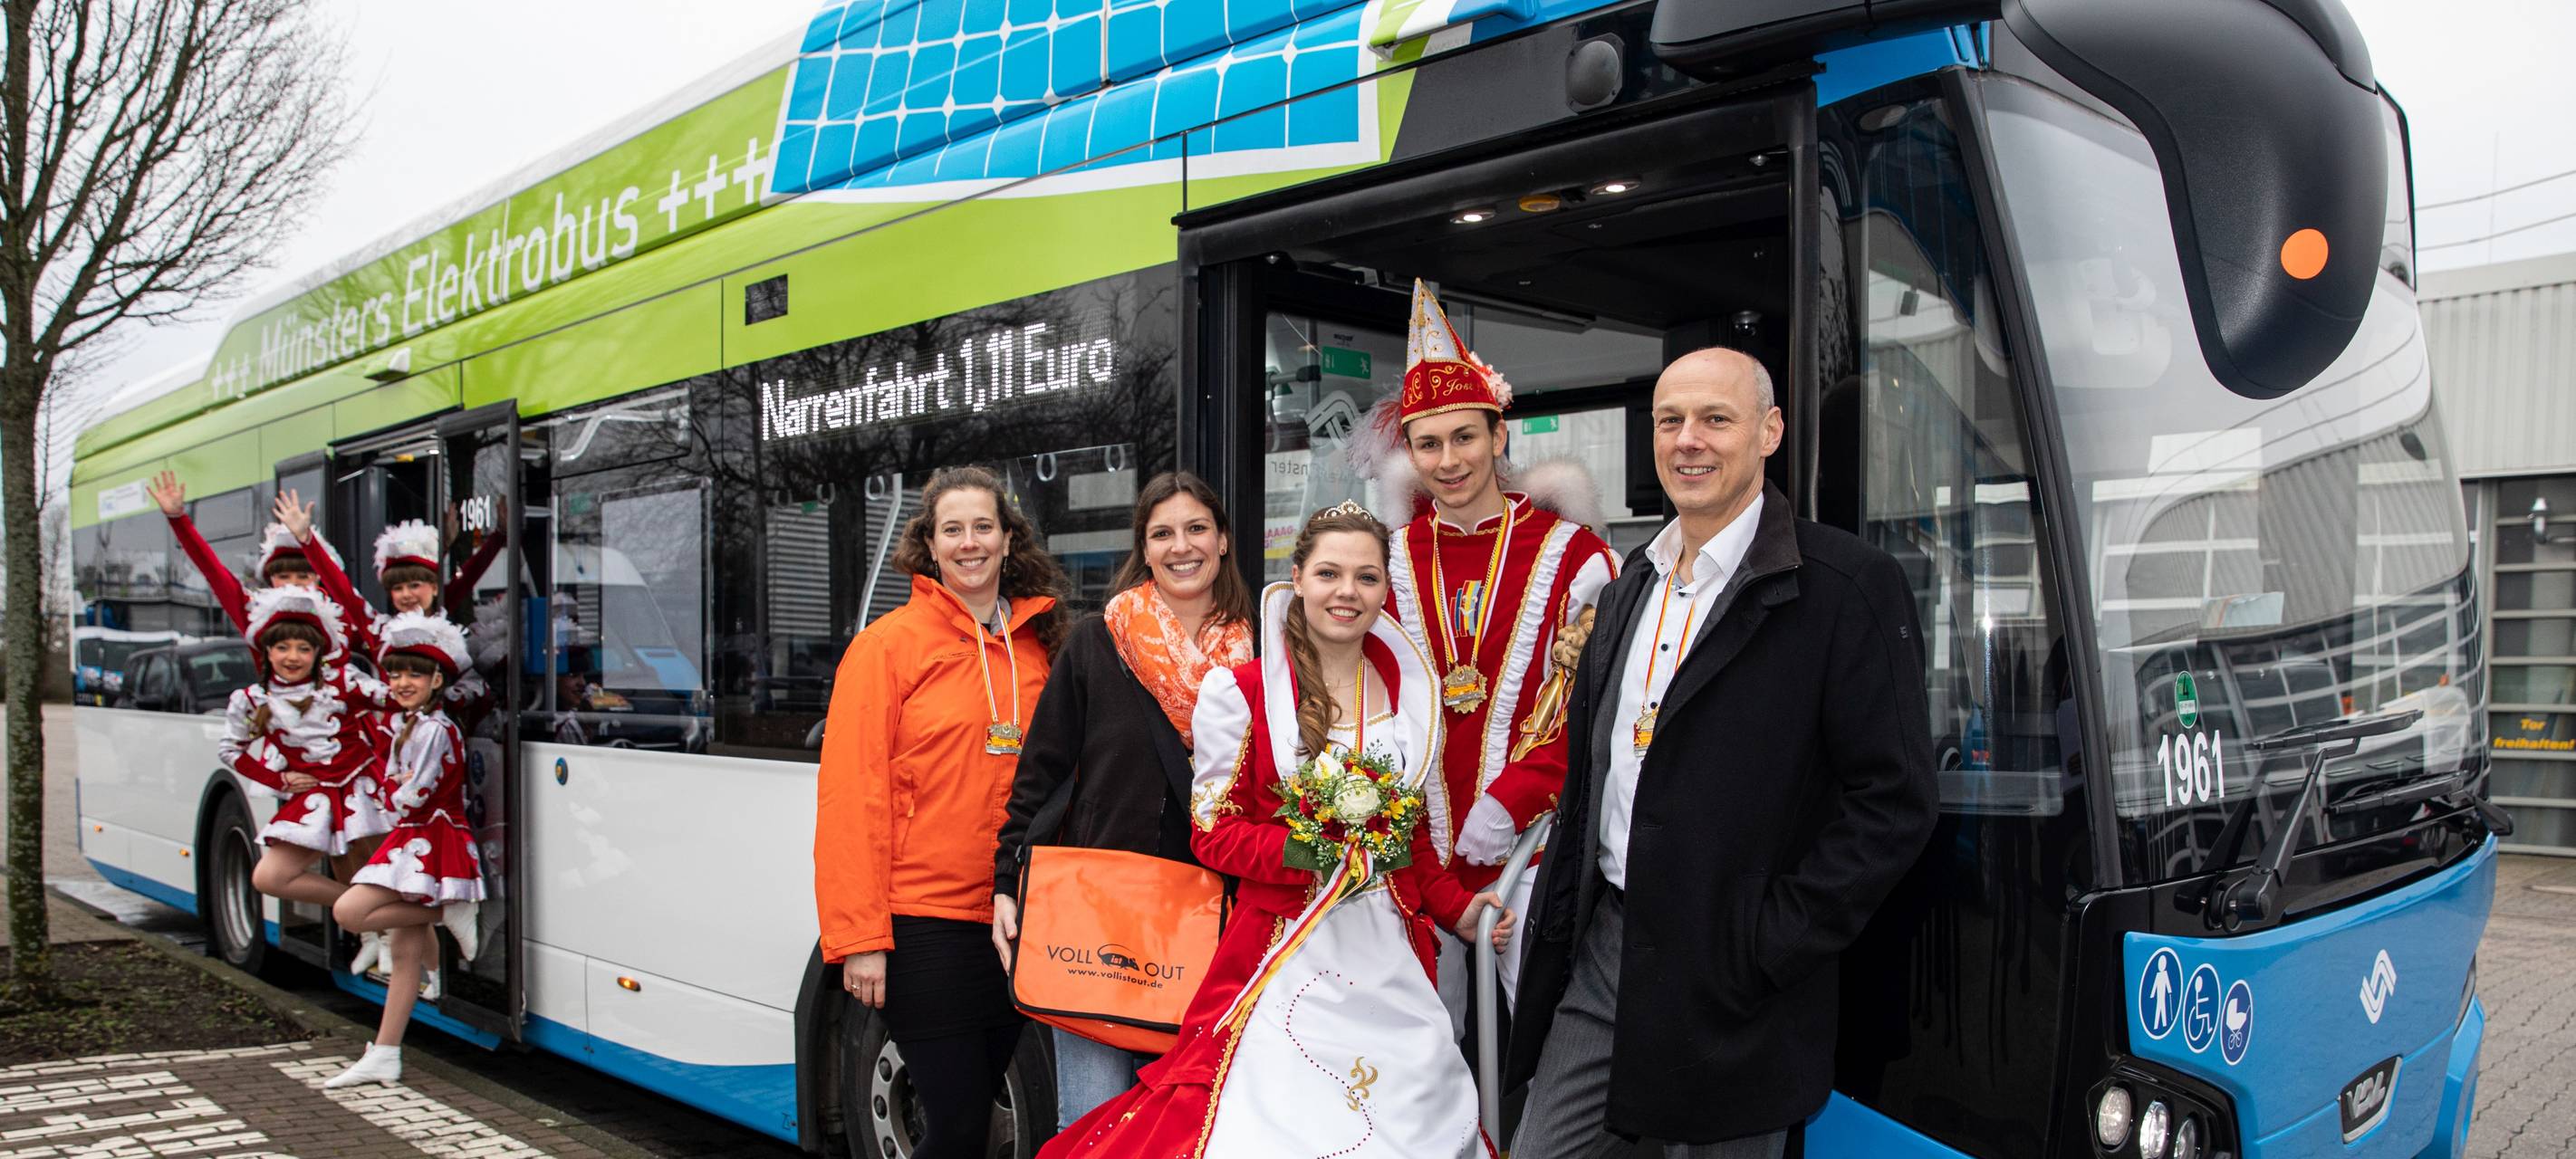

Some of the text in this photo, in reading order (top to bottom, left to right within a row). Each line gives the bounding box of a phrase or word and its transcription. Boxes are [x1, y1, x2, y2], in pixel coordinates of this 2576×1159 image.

[257, 291, 392, 388] Münsters
[402, 186, 639, 339] Elektrobus
[762, 322, 1112, 441] Narrenfahrt 1,11 Euro
[460, 494, 490, 532] 1961
[2183, 675, 2189, 699] 4
[2521, 718, 2546, 731] Tor
[2157, 729, 2225, 807] 1961
[1047, 944, 1093, 964] VOLL
[1144, 962, 1185, 981] OUT
[1067, 967, 1164, 990] www.vollistout.de
[2346, 1070, 2386, 1121] VDL
